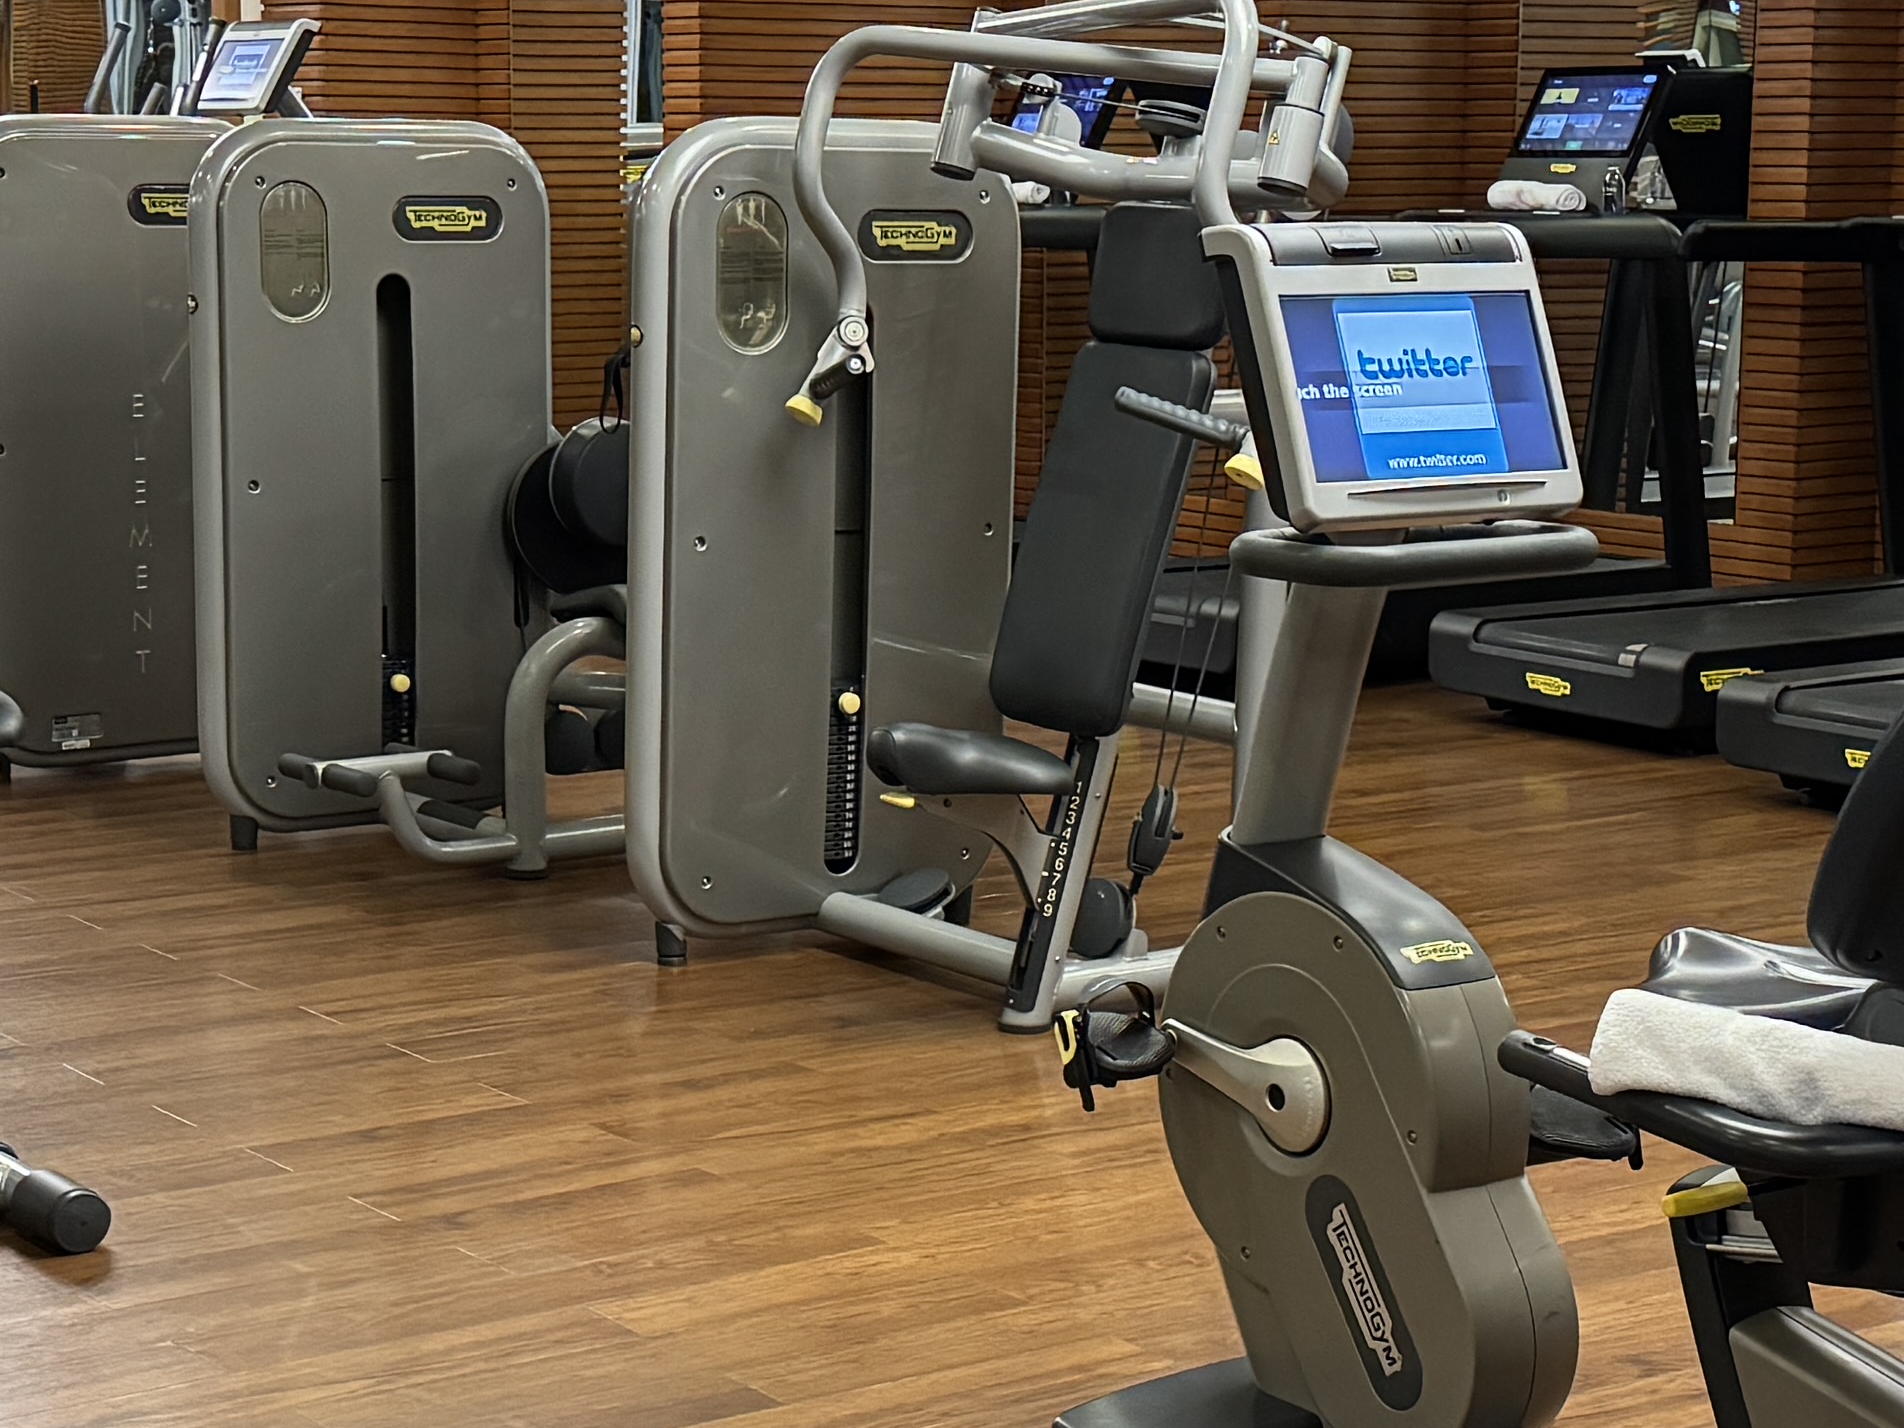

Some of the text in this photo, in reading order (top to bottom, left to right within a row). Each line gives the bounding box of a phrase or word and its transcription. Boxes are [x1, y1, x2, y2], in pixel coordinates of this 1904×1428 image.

[407, 209, 484, 227] TECHNOGYM
[873, 224, 954, 244] TECHNOGYM
[1357, 348, 1473, 381] twitter
[1322, 383, 1350, 399] the
[129, 393, 153, 673] ELEMENT
[1043, 781, 1083, 917] 1 2 3 4 5 6 7 8 9
[1331, 1209, 1397, 1367] TECHNOGYM
